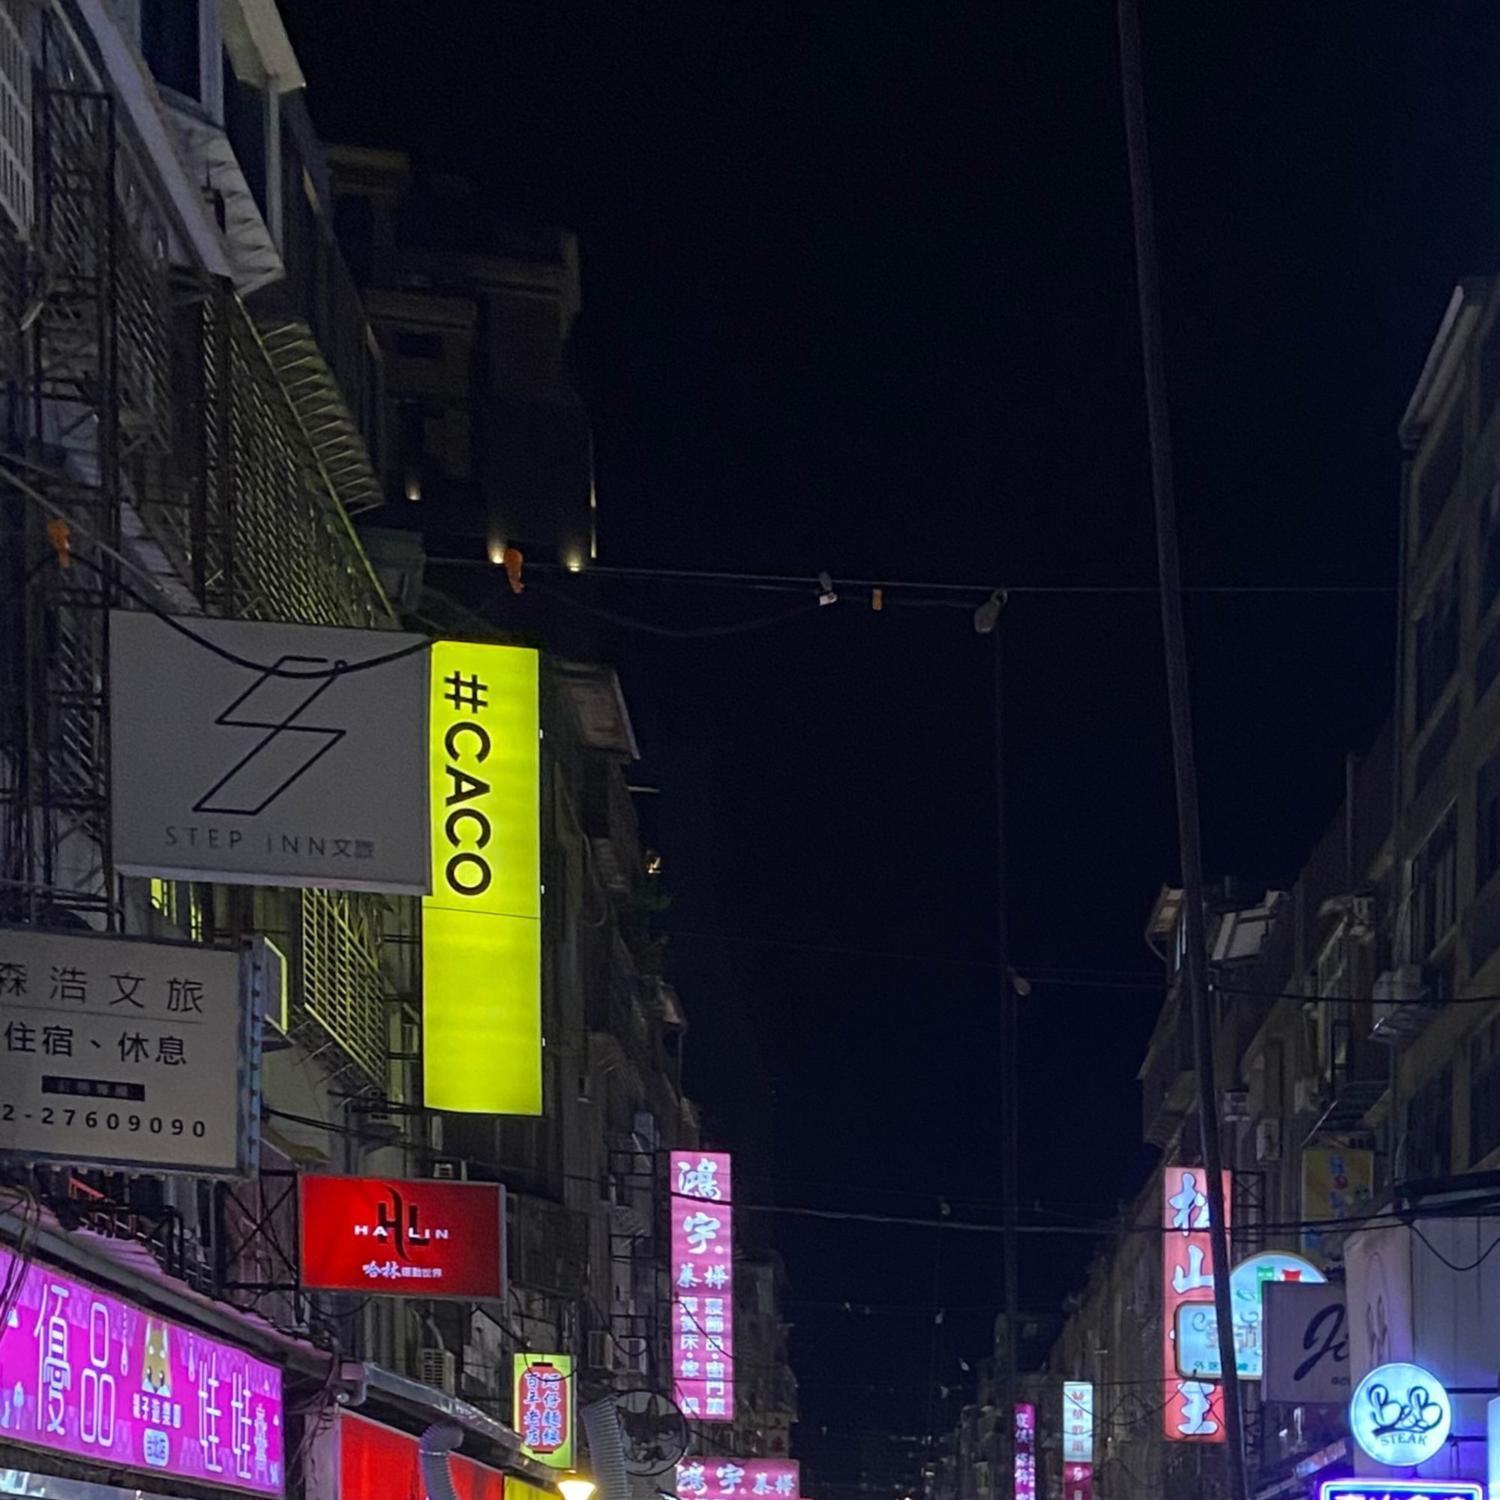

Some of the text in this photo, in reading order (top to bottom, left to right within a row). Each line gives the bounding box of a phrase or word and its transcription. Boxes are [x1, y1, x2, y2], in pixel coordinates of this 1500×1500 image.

[444, 670, 493, 897] #CACO
[165, 826, 243, 849] STEP
[0, 961, 204, 1014] 森浩文旅
[4, 1021, 187, 1067] 住宿、休息
[2, 1103, 206, 1139] 2-27609090
[677, 1157, 722, 1255] 鴻宇
[1368, 1383, 1443, 1435] B&B
[1380, 1433, 1428, 1447] STEAK
